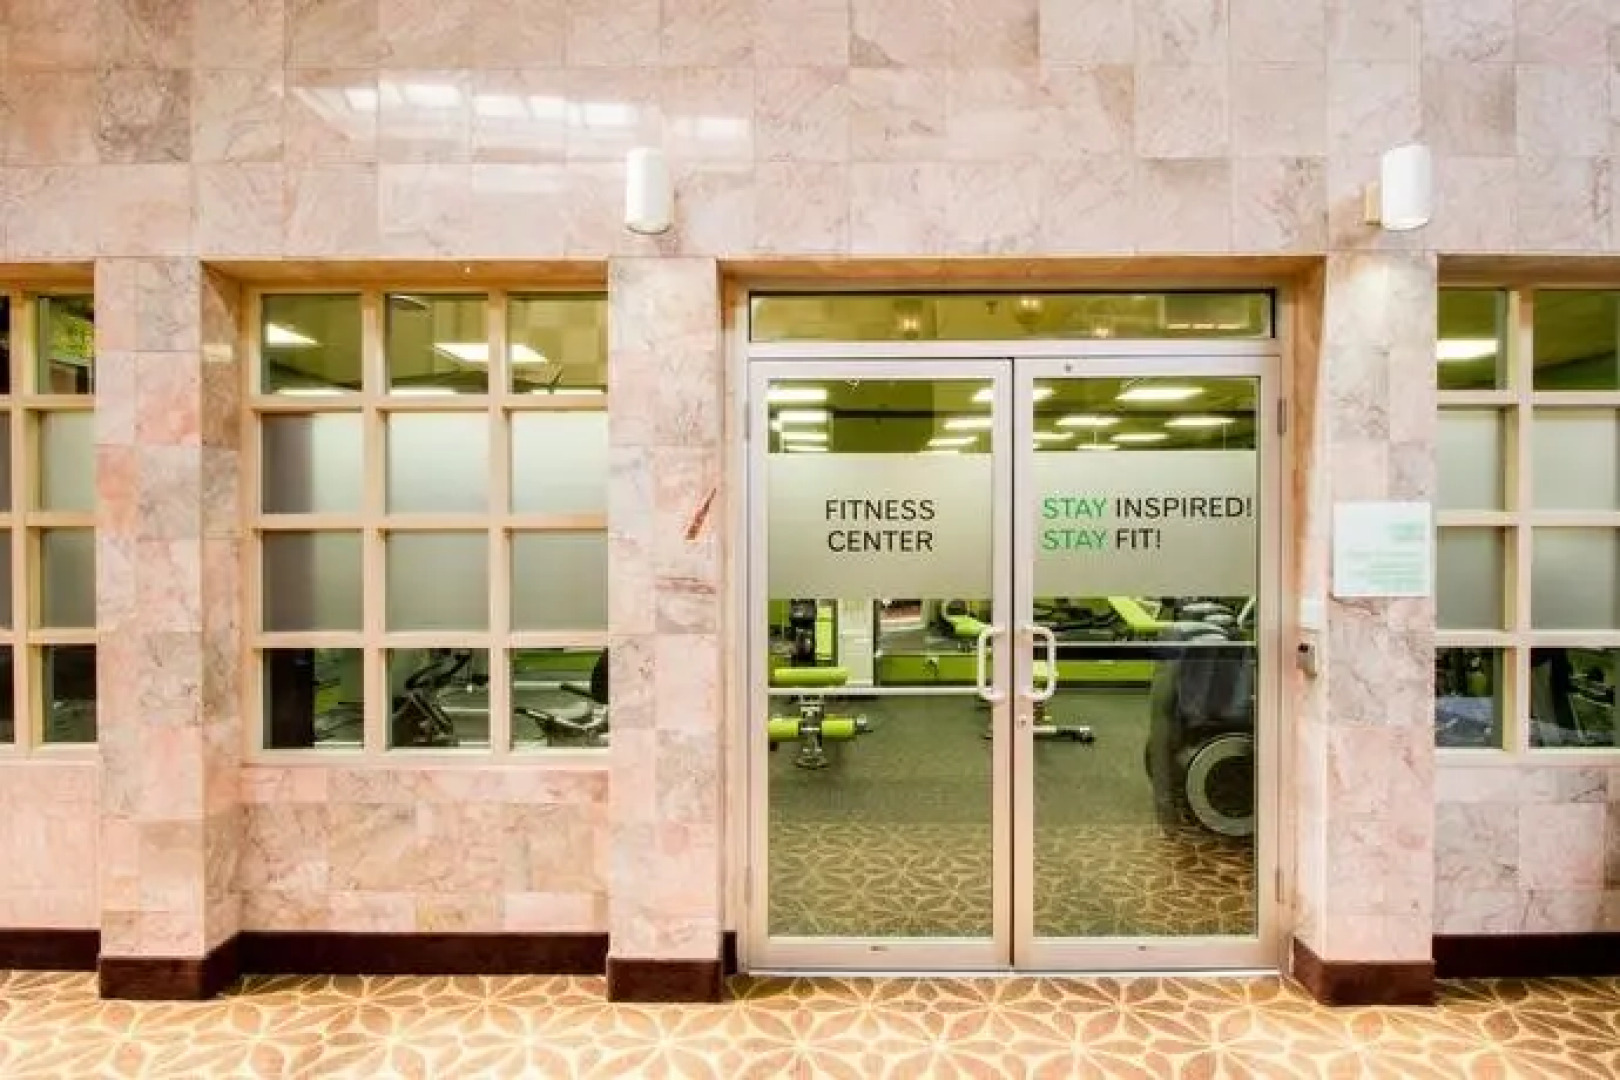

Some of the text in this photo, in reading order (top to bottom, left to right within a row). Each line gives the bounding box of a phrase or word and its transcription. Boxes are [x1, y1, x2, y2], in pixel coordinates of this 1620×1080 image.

[825, 499, 936, 521] FITNESS
[1043, 496, 1253, 519] STAY INSPIRED!
[827, 530, 934, 553] CENTER
[1043, 528, 1162, 551] STAY FIT!
